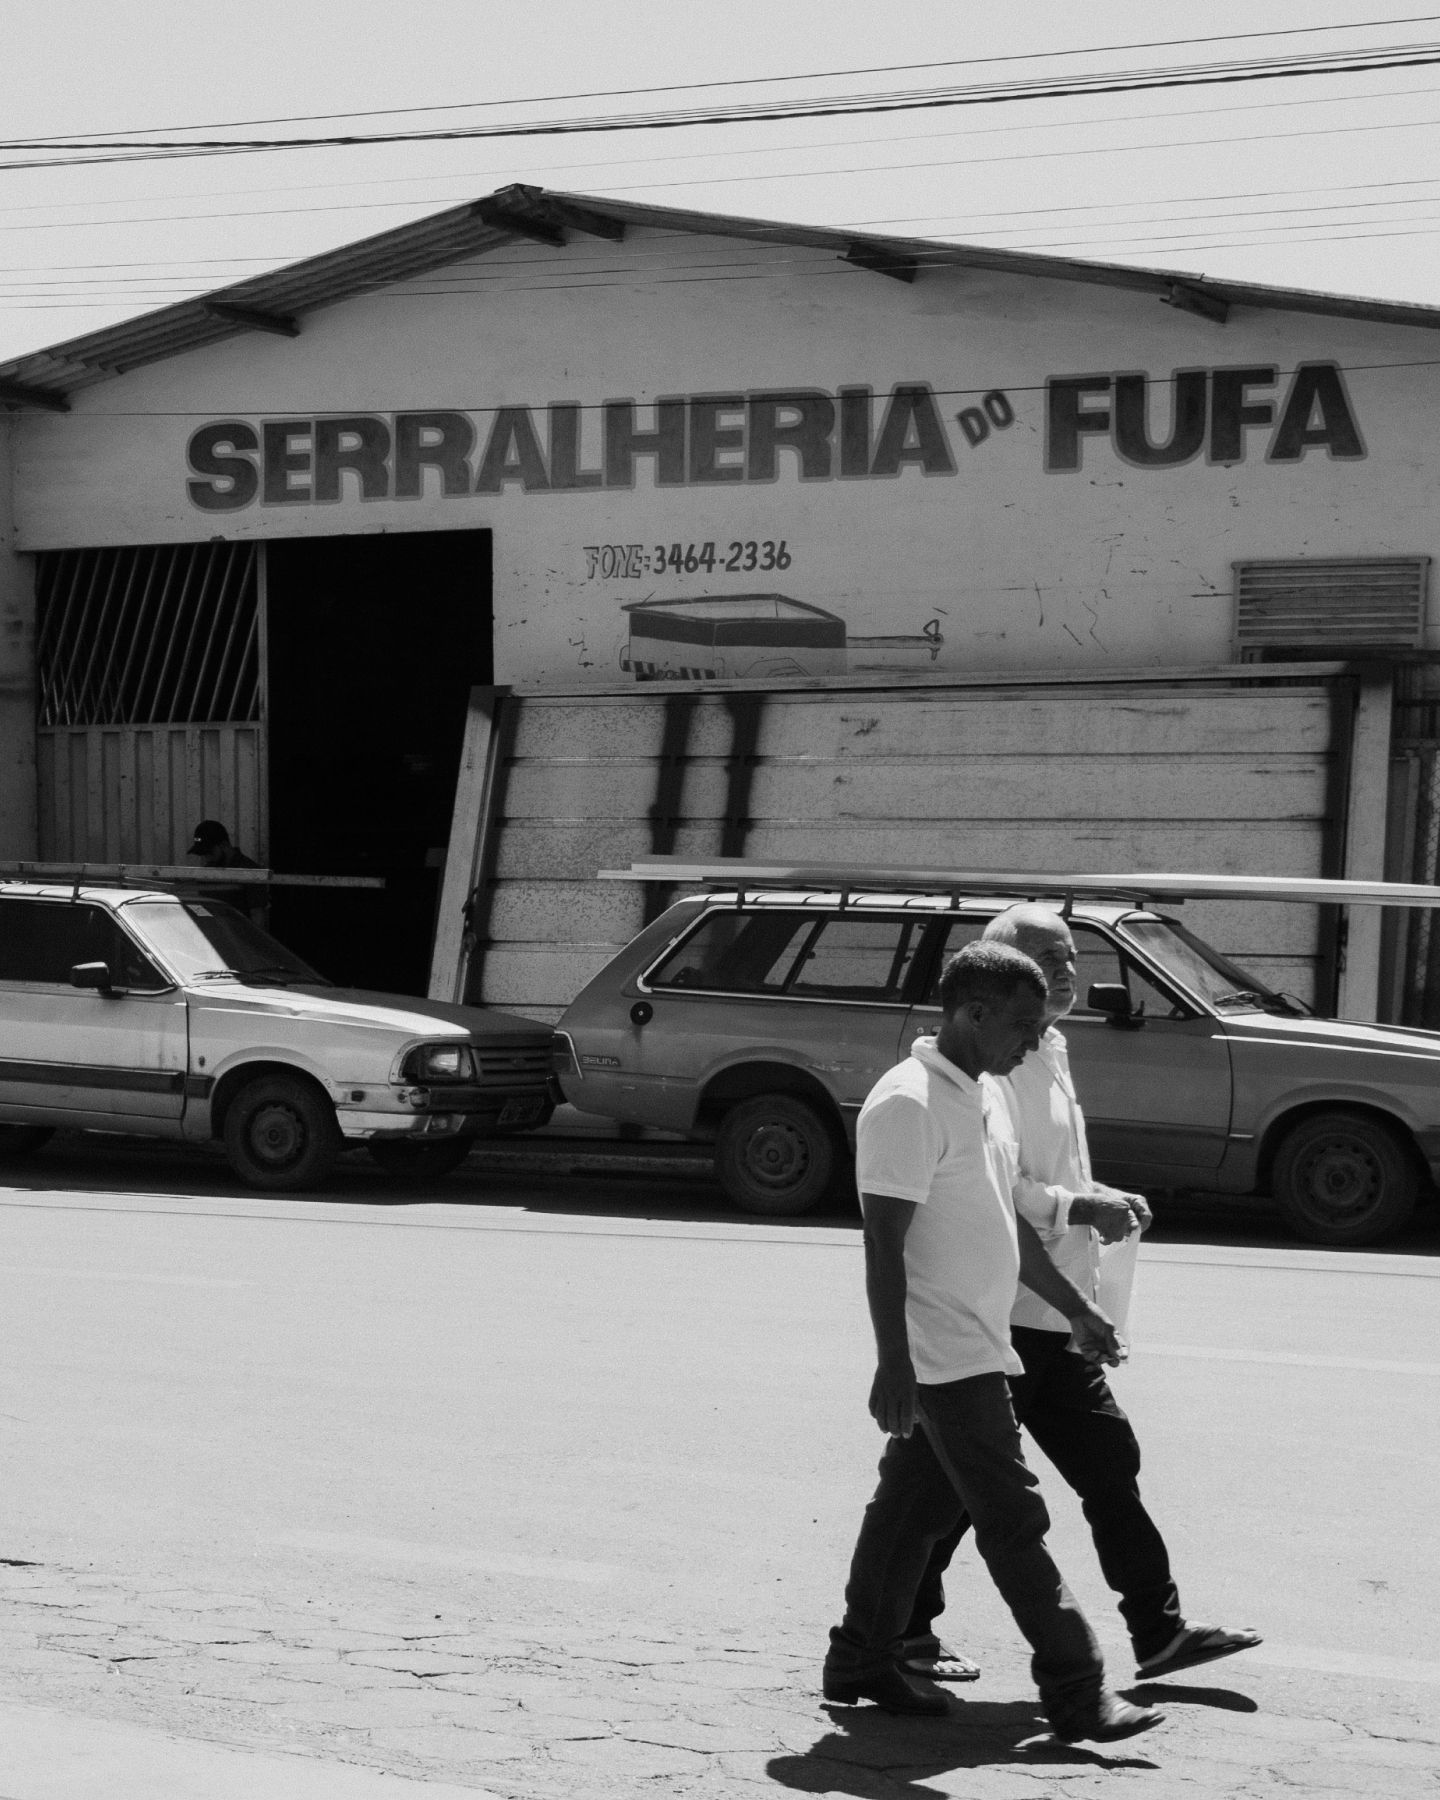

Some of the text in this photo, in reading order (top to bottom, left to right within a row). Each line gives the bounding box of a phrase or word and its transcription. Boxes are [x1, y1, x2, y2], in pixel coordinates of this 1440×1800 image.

[186, 360, 1368, 513] SERRALHERIA DO FUFA
